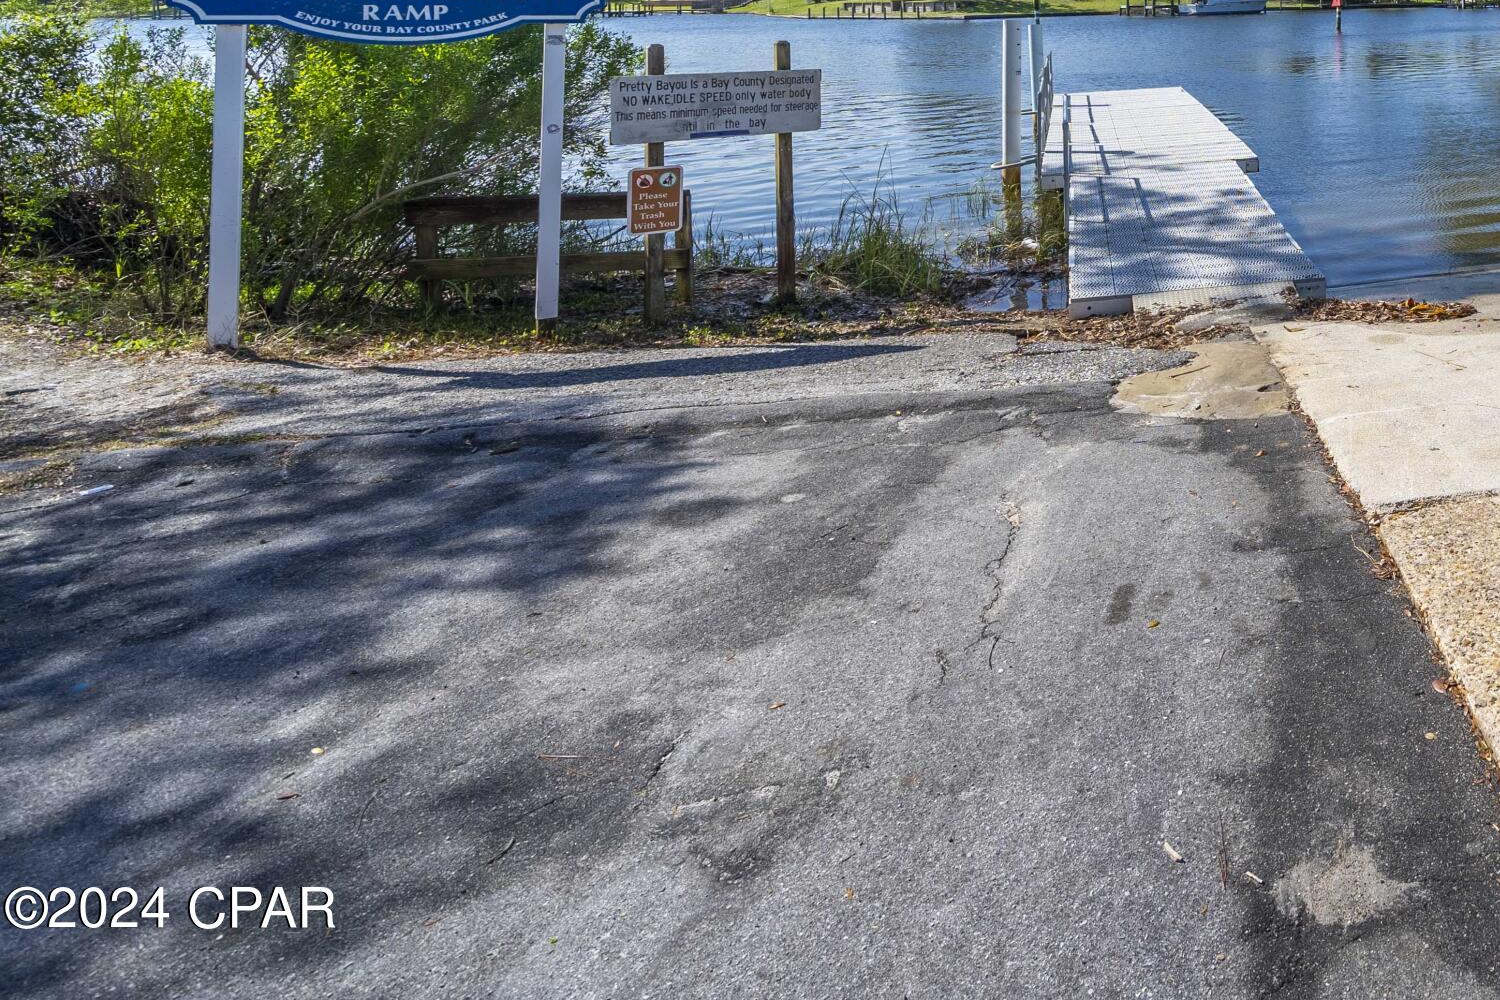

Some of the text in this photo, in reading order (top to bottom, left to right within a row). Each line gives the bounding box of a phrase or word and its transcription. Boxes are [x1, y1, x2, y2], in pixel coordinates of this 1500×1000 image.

[363, 4, 449, 21] RAMP
[294, 11, 508, 34] ENJOY YOUR BAY COUNTY PARK
[619, 81, 652, 94] Pretty
[656, 80, 687, 93] Bayou
[702, 79, 708, 88] a
[711, 78, 730, 90] Bay
[733, 76, 766, 89] County
[769, 74, 815, 87] Designated
[622, 96, 637, 106] NO
[699, 91, 732, 102] SPEED
[735, 90, 756, 103] only
[760, 89, 786, 99] water
[789, 88, 811, 99] body
[615, 111, 633, 122] This
[637, 110, 667, 120] means
[669, 107, 709, 118] minimum
[740, 104, 768, 114] needed
[771, 102, 782, 113] for
[785, 101, 819, 112] steerage
[706, 119, 715, 130] in
[725, 119, 740, 129] the
[749, 118, 767, 130] bay
[639, 192, 668, 200] Please
[633, 202, 655, 211] Take
[640, 211, 665, 220] Trash
[634, 220, 676, 230] With You
